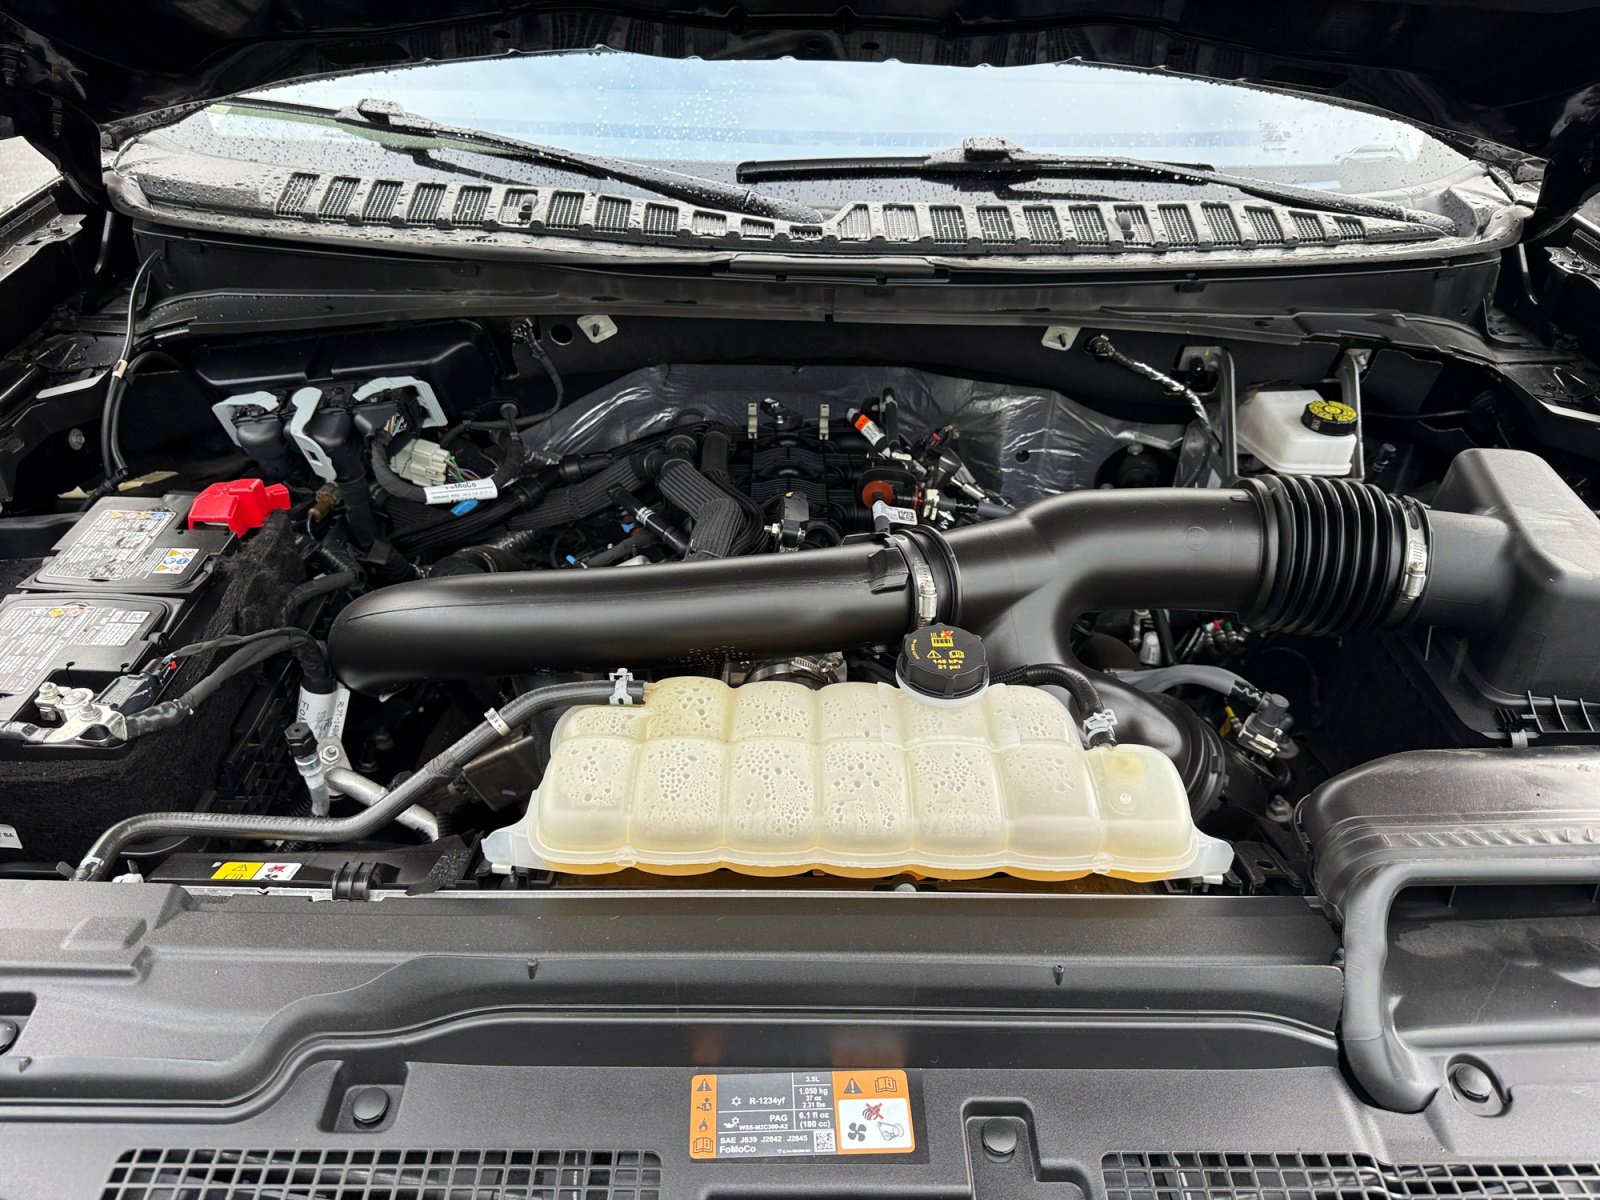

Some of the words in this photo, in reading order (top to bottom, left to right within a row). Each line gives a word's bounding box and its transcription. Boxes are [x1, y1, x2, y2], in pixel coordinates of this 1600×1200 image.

[798, 1087, 818, 1095] 1.050
[818, 1086, 828, 1096] kg
[749, 1096, 786, 1106] R-1234yf
[769, 1114, 788, 1122] PAG
[799, 1120, 817, 1129] (180
[818, 1120, 831, 1129] cc)
[720, 1136, 736, 1144] SAE
[761, 1135, 782, 1143] J2842
[787, 1134, 808, 1142] J2845
[719, 1145, 757, 1154] FoMoCo
